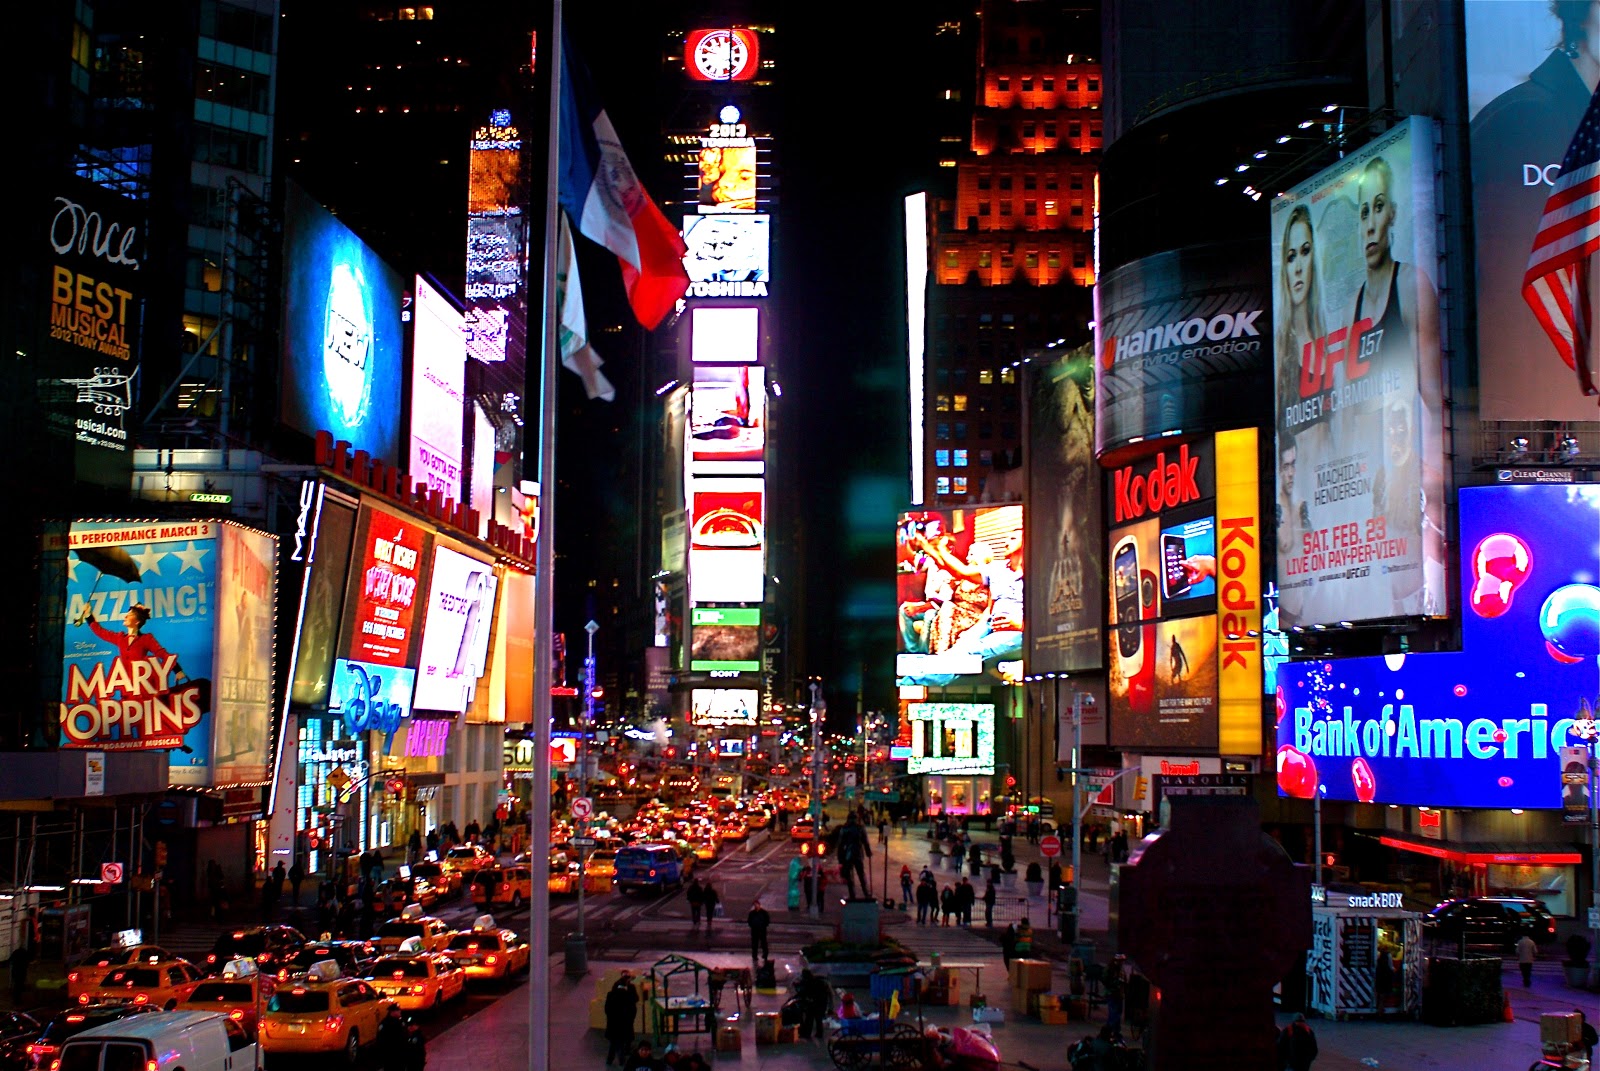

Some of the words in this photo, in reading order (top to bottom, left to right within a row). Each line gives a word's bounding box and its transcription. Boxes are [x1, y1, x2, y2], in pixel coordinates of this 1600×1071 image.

[709, 124, 747, 138] 2013
[53, 265, 132, 325] BEST
[686, 282, 768, 297] TOSHIBA
[51, 302, 130, 348] MUSICAL
[51, 325, 71, 342] 2012
[73, 331, 97, 351] TONY
[98, 338, 131, 360] AWARD
[1131, 350, 1178, 371] driving
[1184, 340, 1261, 360] emotion
[1300, 318, 1373, 398] UFC
[1359, 330, 1384, 359] 157
[1286, 395, 1325, 428] ROUSEY
[75, 419, 126, 440] usical.com
[1114, 444, 1200, 523] Kodak
[1317, 462, 1360, 488] MACHIDA
[1314, 478, 1371, 507] HENDERSON
[82, 529, 157, 545] PERFORMANCE
[160, 525, 198, 538] MARCH
[201, 525, 209, 535] 3
[1303, 529, 1329, 555] SAT.
[1333, 522, 1362, 549] FEB.
[1366, 515, 1387, 543] 23
[1286, 556, 1309, 576] LIVE
[1311, 553, 1325, 572] ON
[1328, 537, 1408, 569] PAY-PER-VIEW
[1221, 517, 1256, 670] Kodak
[70, 654, 178, 701] MARY
[710, 670, 740, 678] SONY
[145, 737, 180, 747] MUSICAL
[405, 719, 450, 757] FOREVER
[1295, 706, 1361, 757] Bank
[1161, 776, 1246, 785] MARQUIS
[1348, 892, 1404, 908] snackBOX
